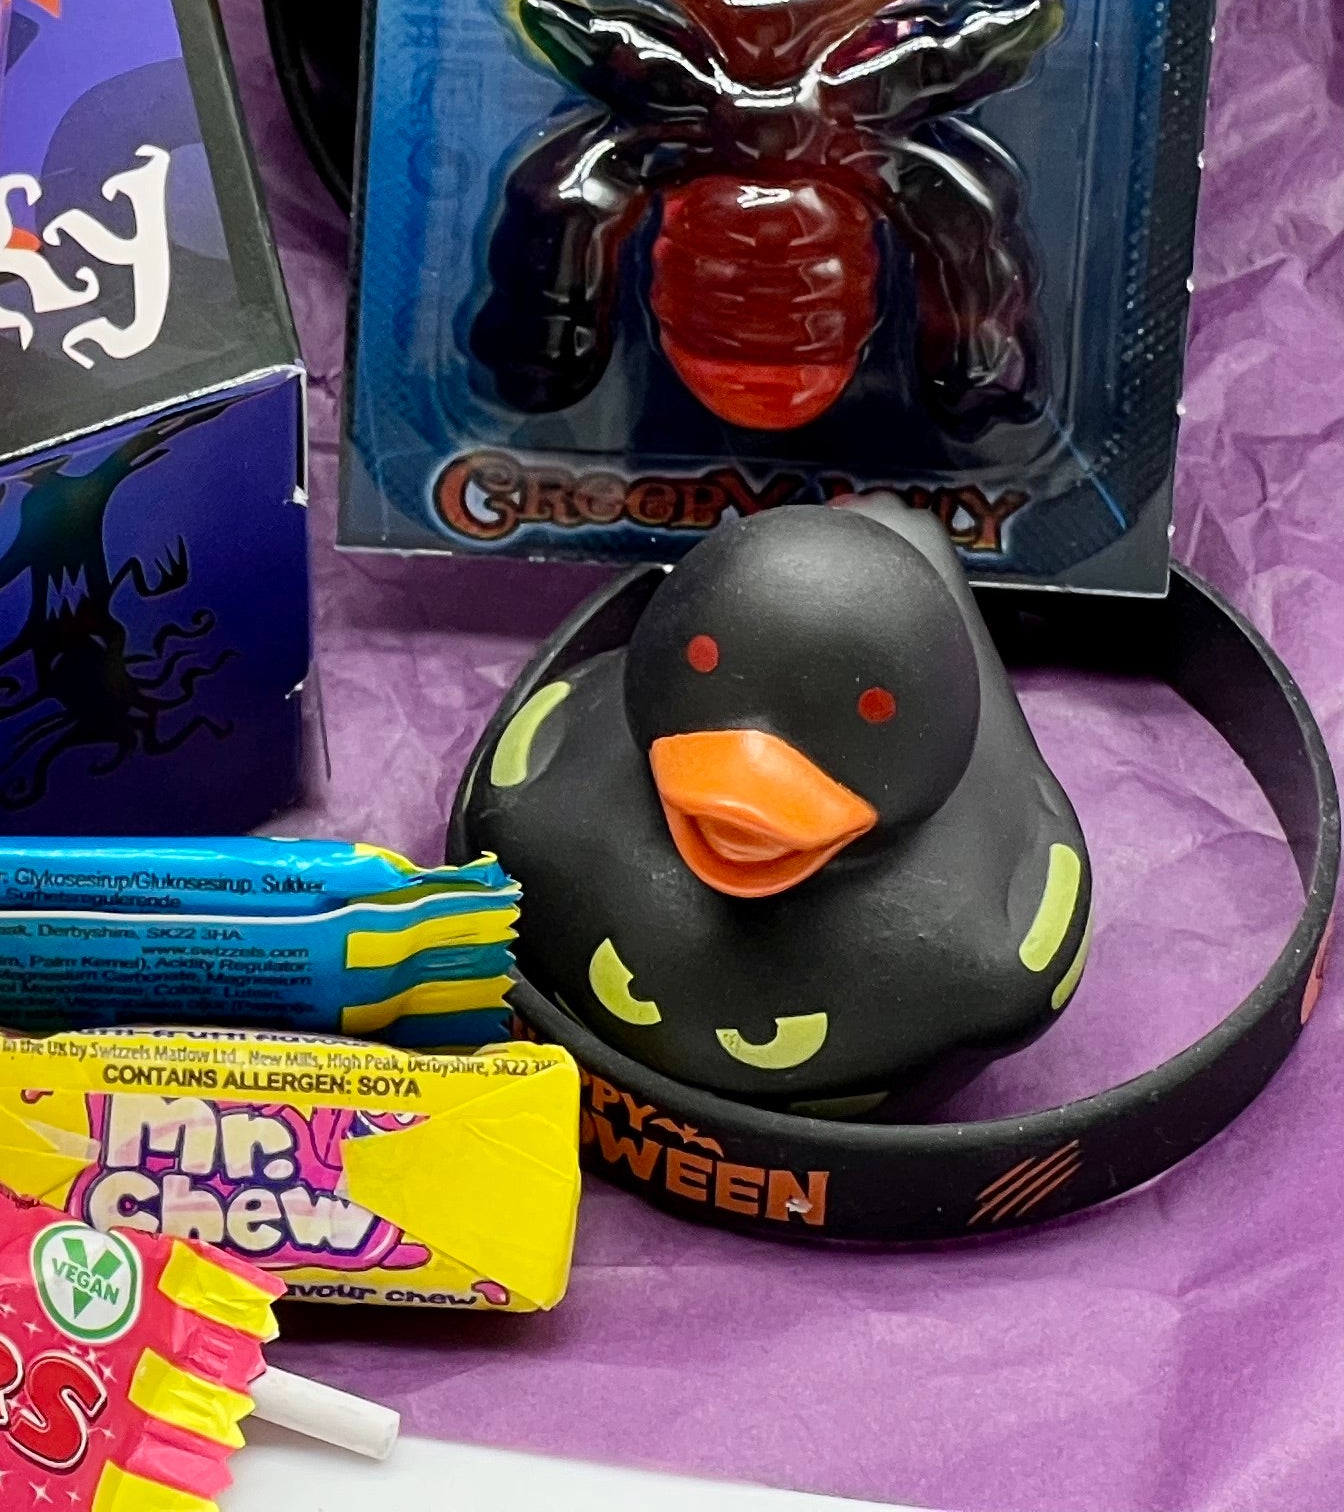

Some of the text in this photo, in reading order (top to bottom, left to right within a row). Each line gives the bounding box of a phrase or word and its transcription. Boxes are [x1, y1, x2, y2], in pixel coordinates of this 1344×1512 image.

[21, 1040, 43, 1055] the
[70, 1042, 87, 1062] by
[327, 1053, 362, 1073] High
[365, 1054, 403, 1073] Peak,
[102, 1064, 423, 1099] CONTAINS ALLERGEN: SOYA
[582, 1070, 657, 1132] PY
[109, 1094, 297, 1181] Mr.
[582, 1108, 830, 1226] WEEN
[51, 1257, 120, 1307] VEGAN
[385, 1287, 477, 1306] chew
